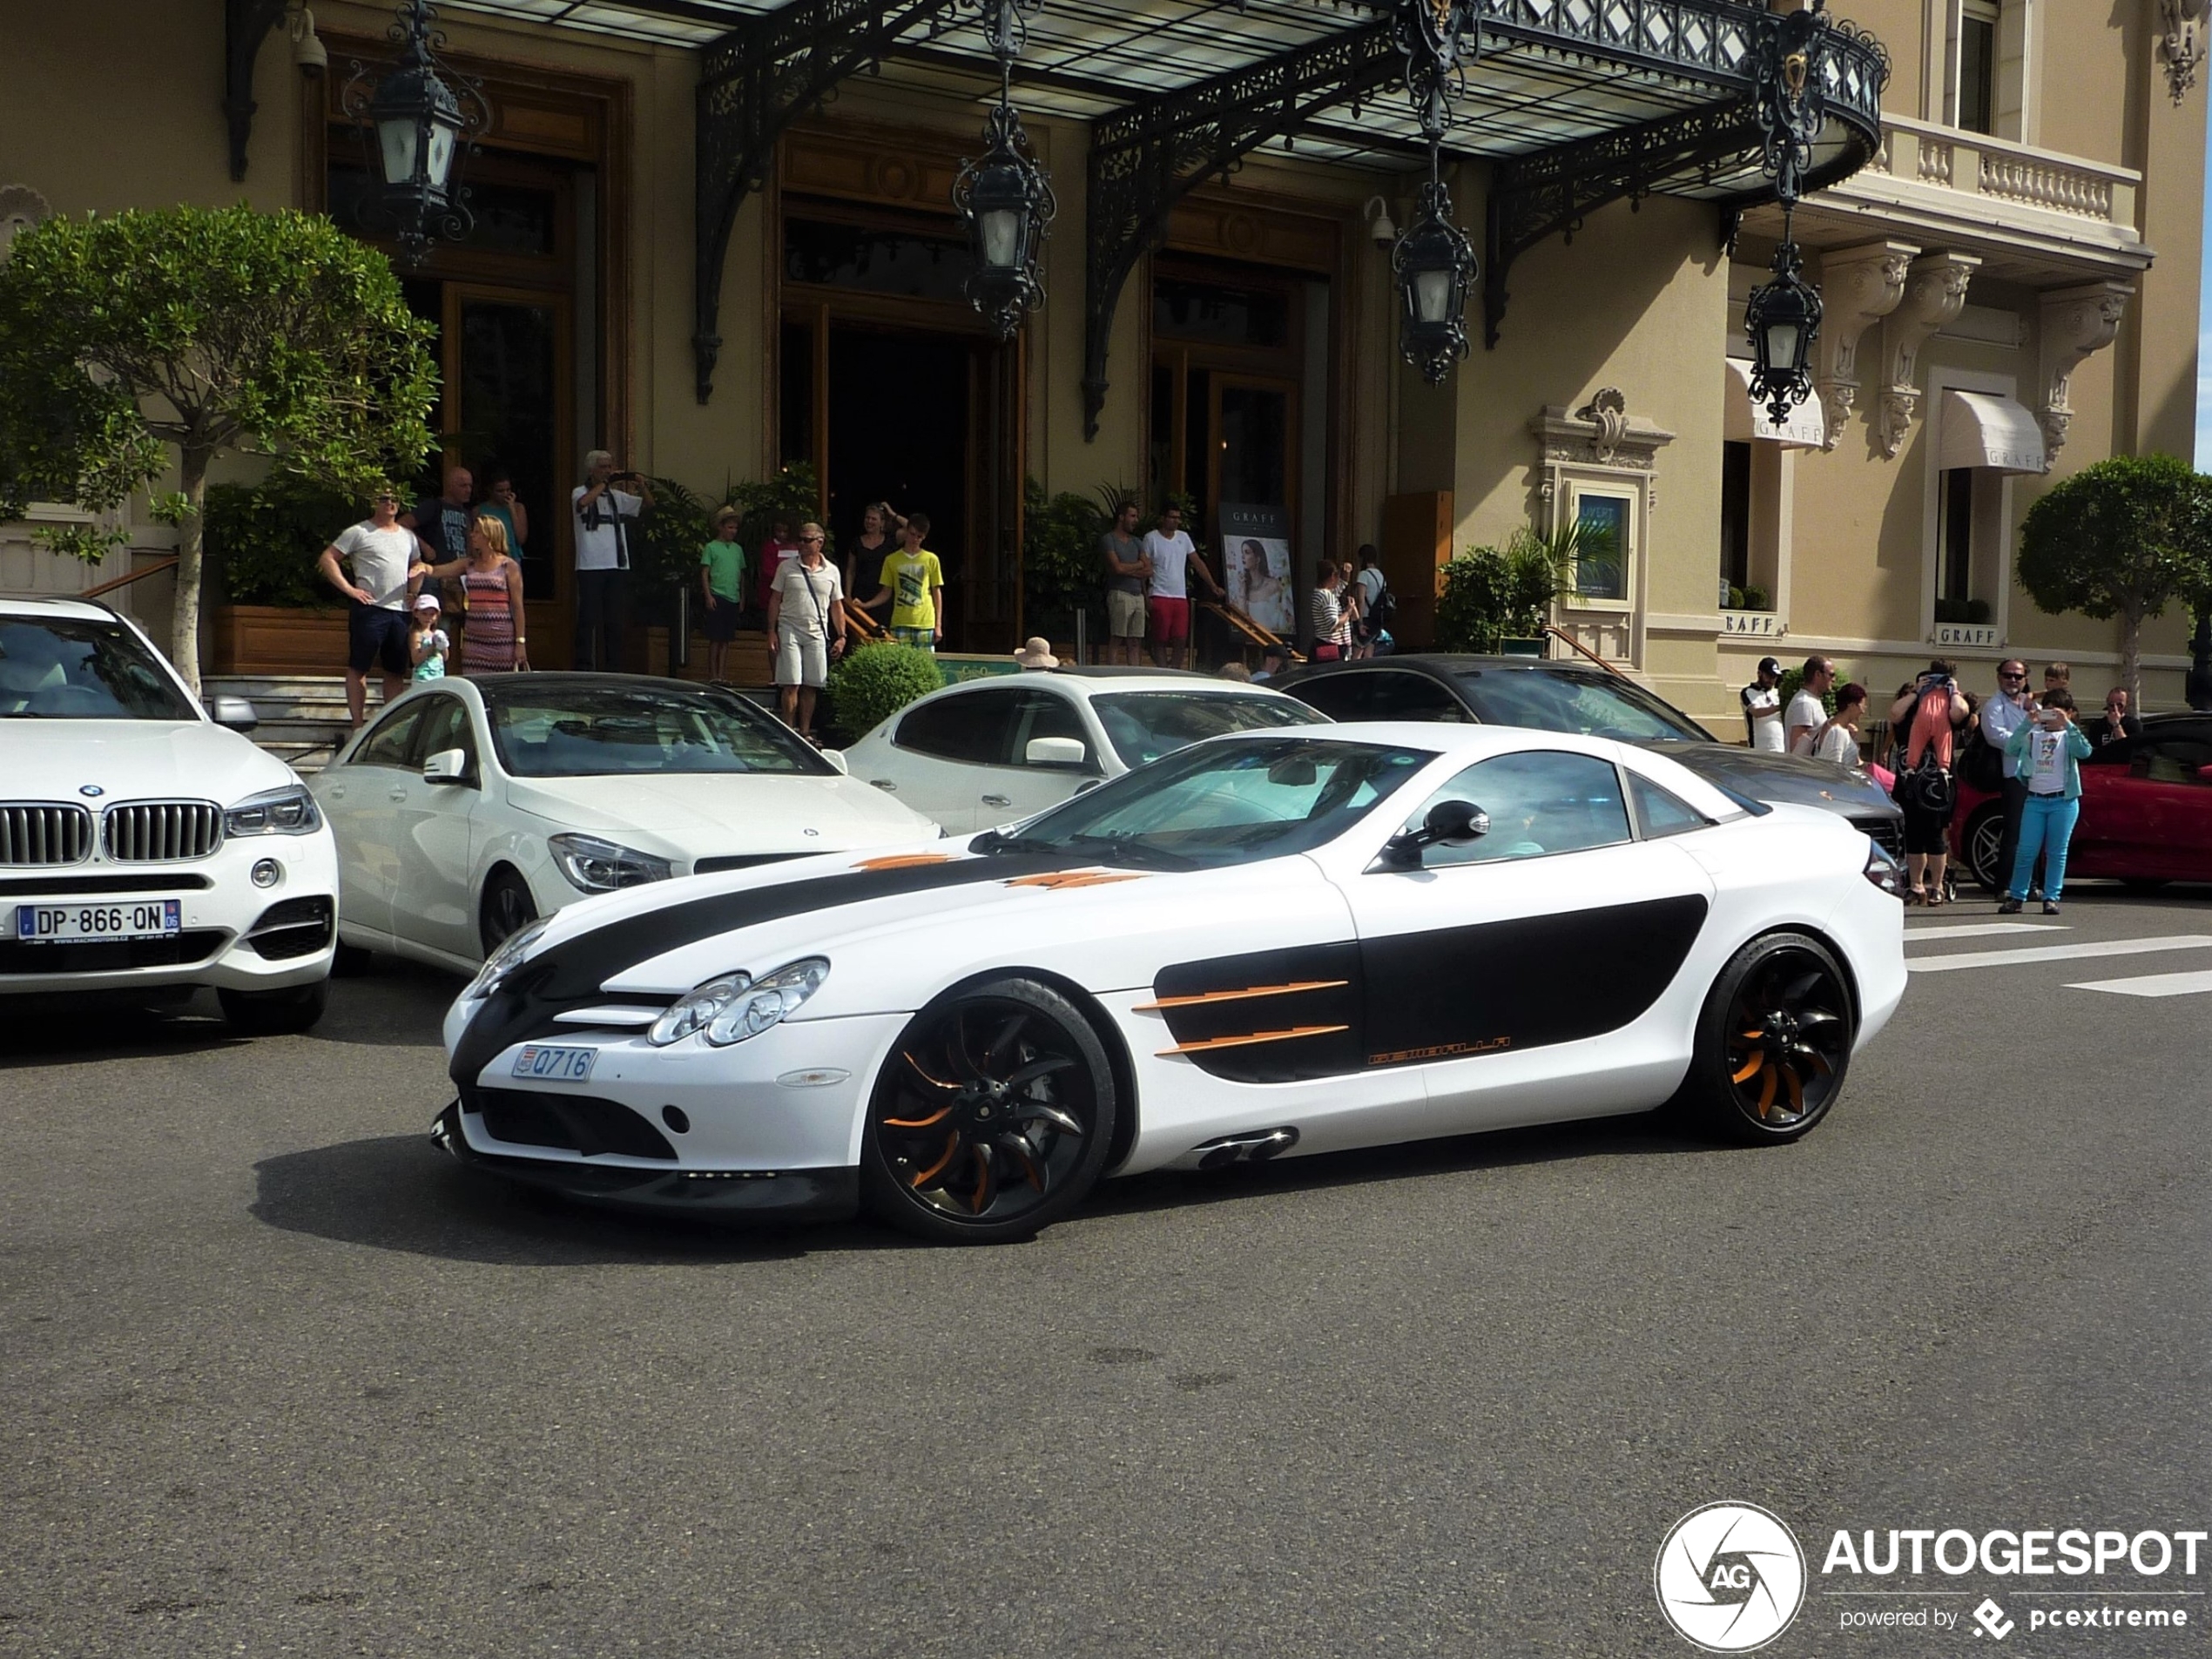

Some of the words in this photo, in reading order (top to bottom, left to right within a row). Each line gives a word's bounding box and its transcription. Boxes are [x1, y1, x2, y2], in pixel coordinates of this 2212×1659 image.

[1990, 450, 2041, 469] GRAFF
[1232, 511, 1276, 523] GRAFF
[1941, 629, 1994, 644] GRAFF
[165, 915, 179, 929] 06
[1368, 1036, 1511, 1065] GEMBALLA
[534, 1049, 590, 1076] Q716
